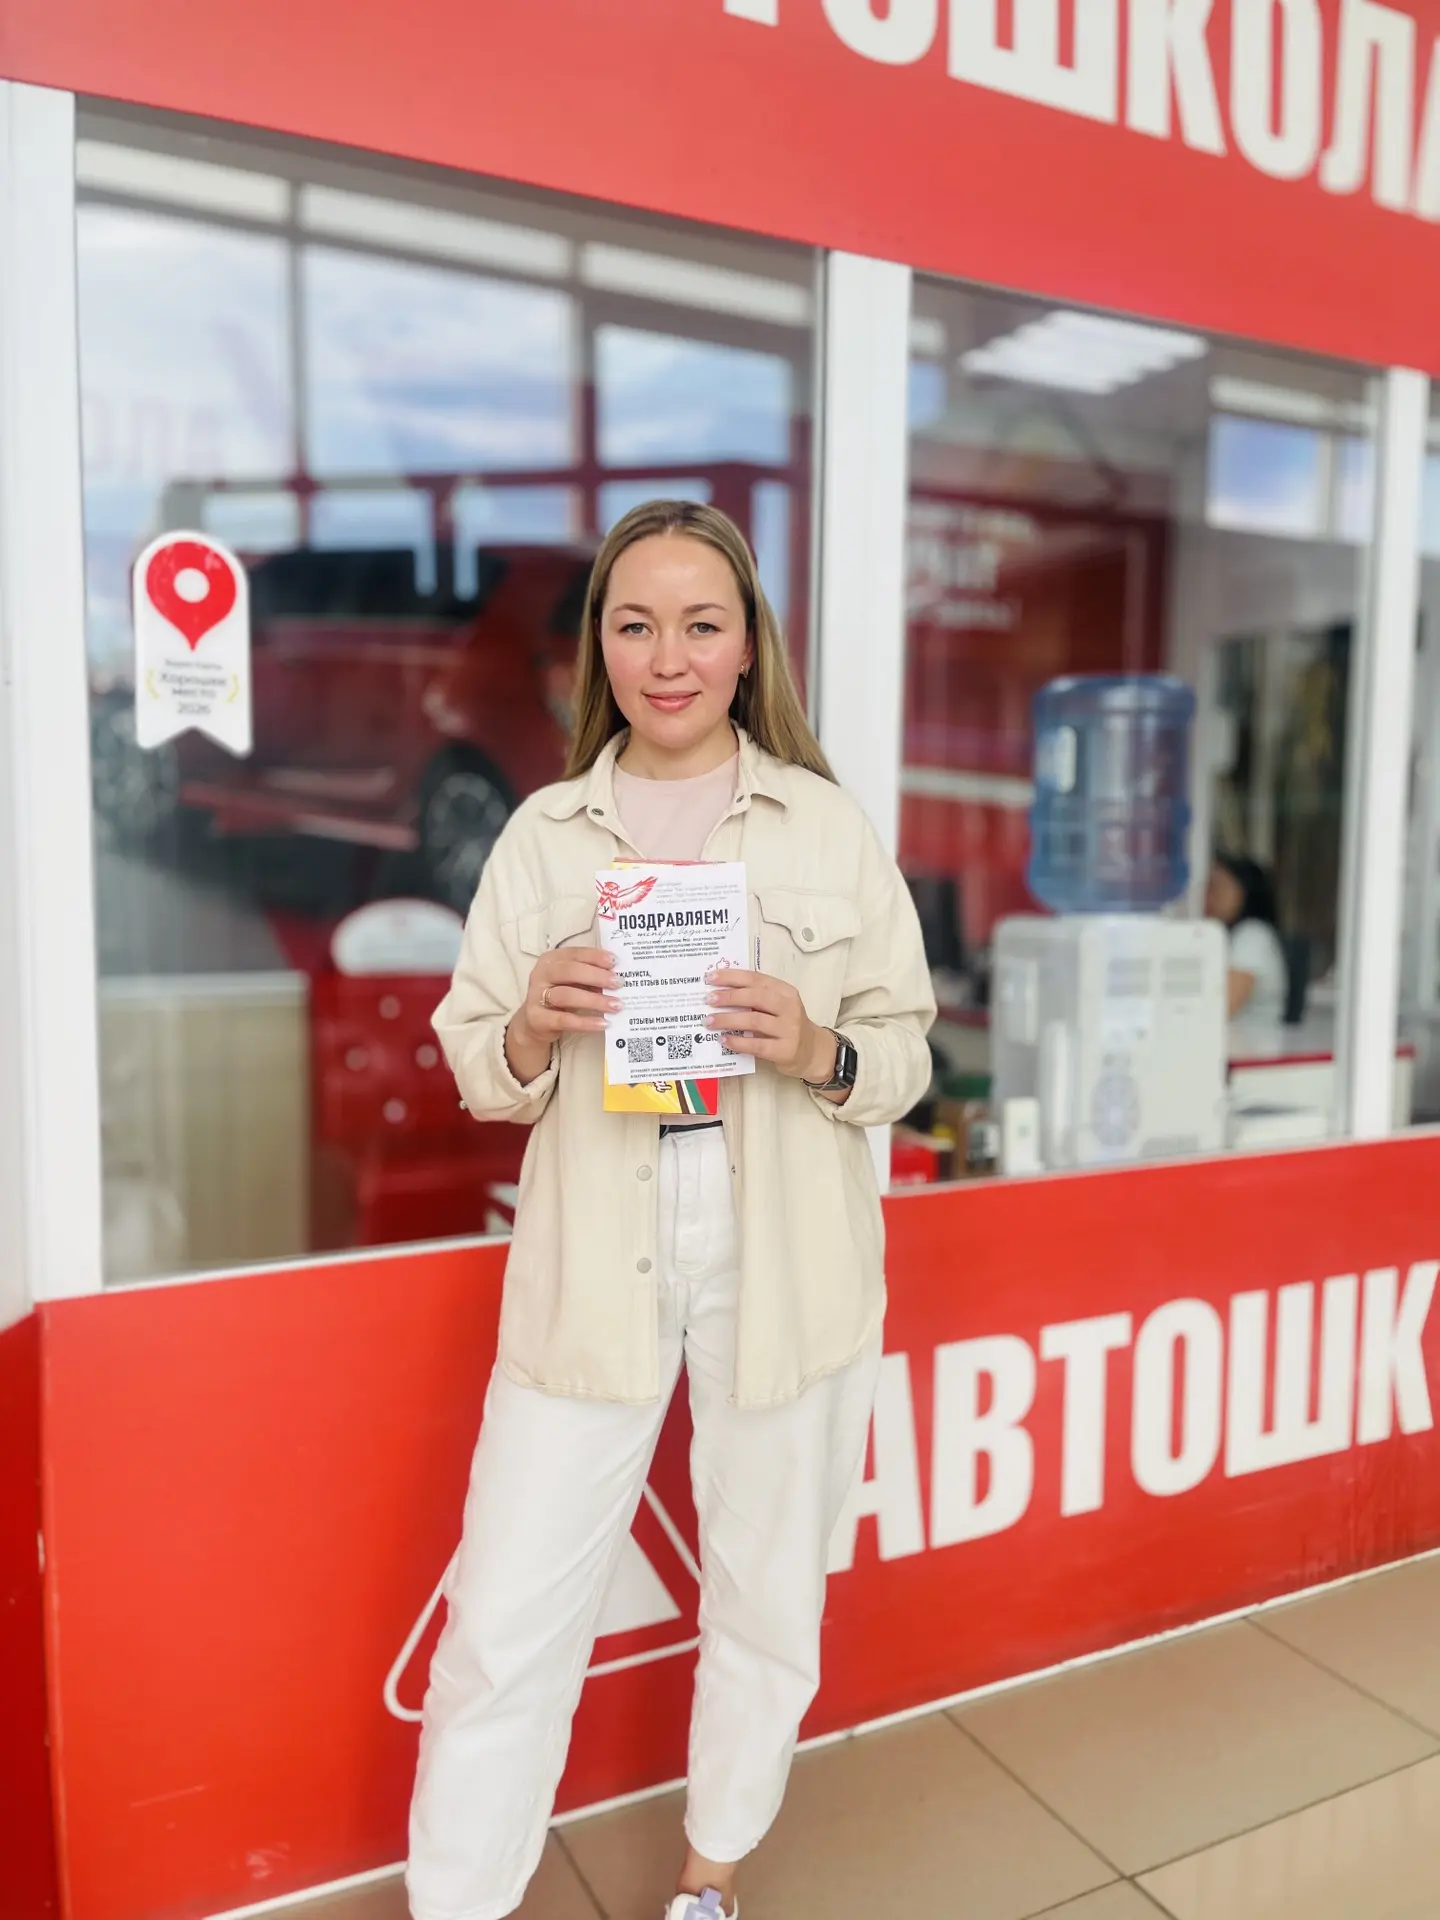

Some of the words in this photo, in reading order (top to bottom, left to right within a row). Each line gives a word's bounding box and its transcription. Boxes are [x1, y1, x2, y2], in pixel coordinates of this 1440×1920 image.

[618, 908, 729, 931] ПОЗДРАВЛЯЕМ!
[640, 979, 660, 987] ОТЗЫВ
[660, 978, 669, 986] ОБ
[669, 976, 701, 985] ОБУЧЕНИИ!
[629, 1017, 655, 1025] ОТЗЫВЫ
[656, 1015, 679, 1024] МОЖНО
